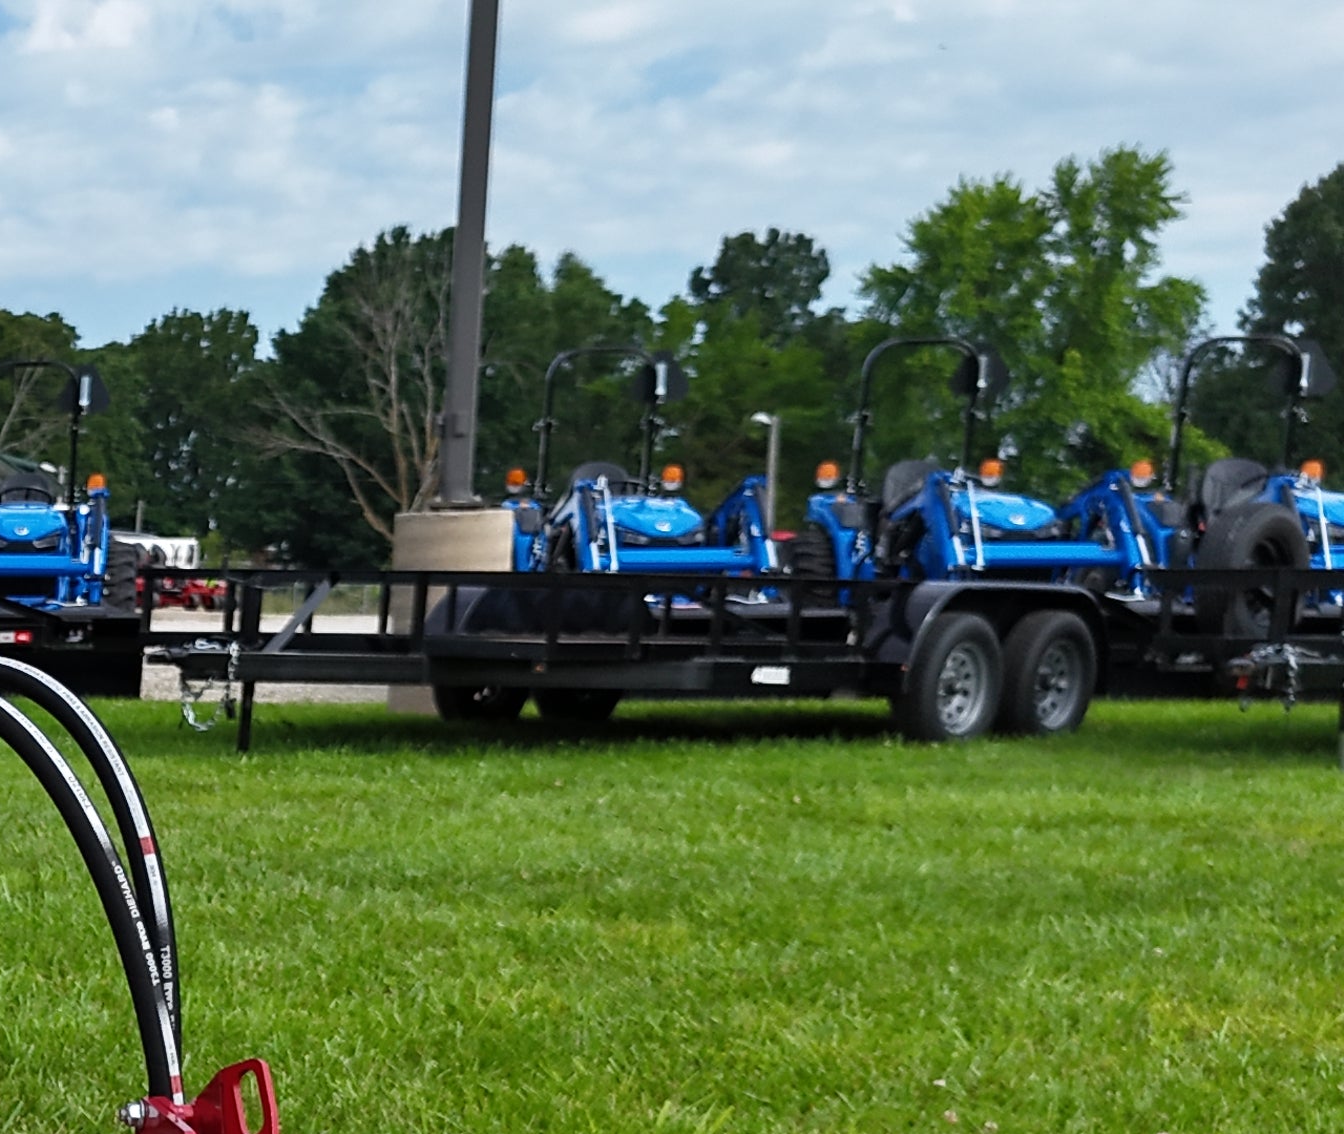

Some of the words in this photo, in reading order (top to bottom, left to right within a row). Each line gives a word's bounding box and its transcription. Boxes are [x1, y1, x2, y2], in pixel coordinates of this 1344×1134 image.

[79, 708, 106, 739] ABRASION
[101, 738, 125, 776] RESISTANT
[160, 944, 172, 979] T3000
